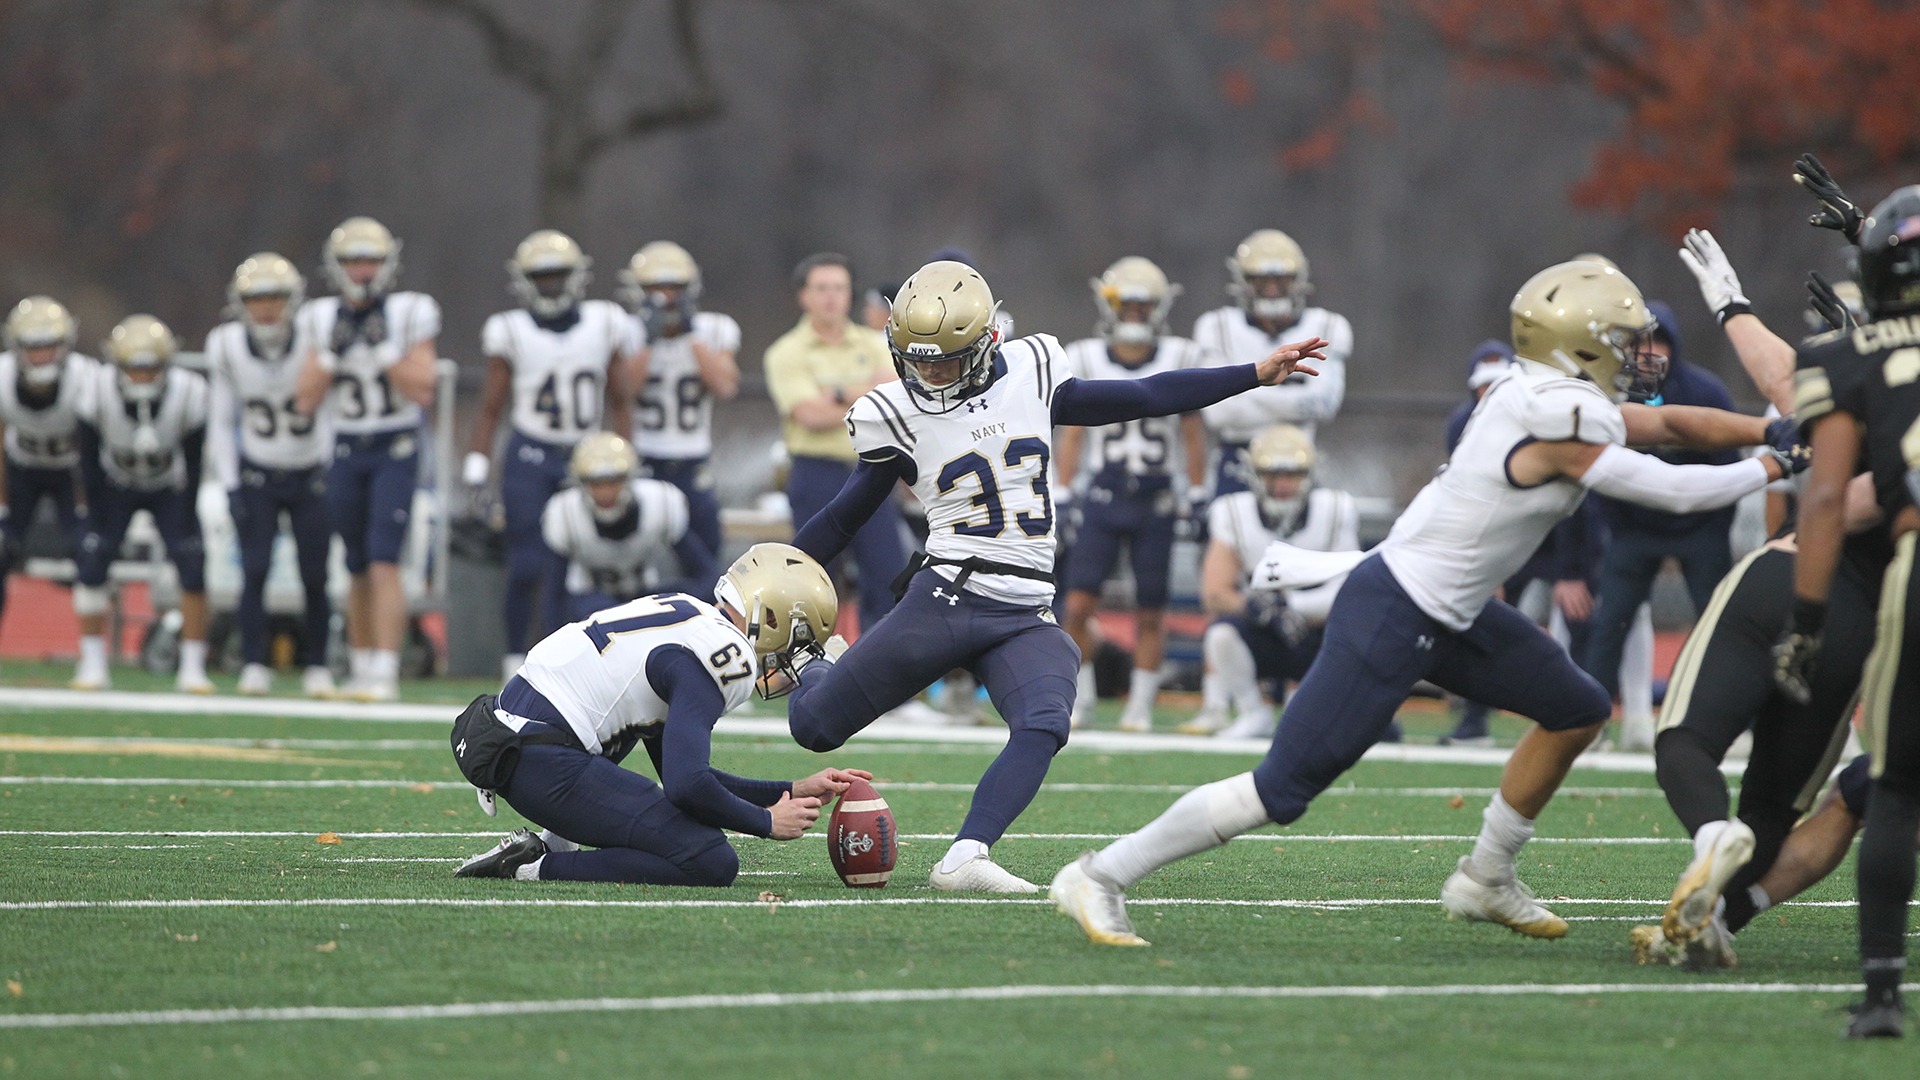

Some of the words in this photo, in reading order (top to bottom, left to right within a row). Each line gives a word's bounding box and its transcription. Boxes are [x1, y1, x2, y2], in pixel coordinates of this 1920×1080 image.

[911, 347, 936, 356] NAVY
[331, 370, 395, 419] 31
[535, 371, 599, 430] 40
[637, 374, 706, 431] 58
[970, 422, 1006, 442] NAVY
[935, 434, 1053, 539] 33
[709, 641, 753, 687] 67
